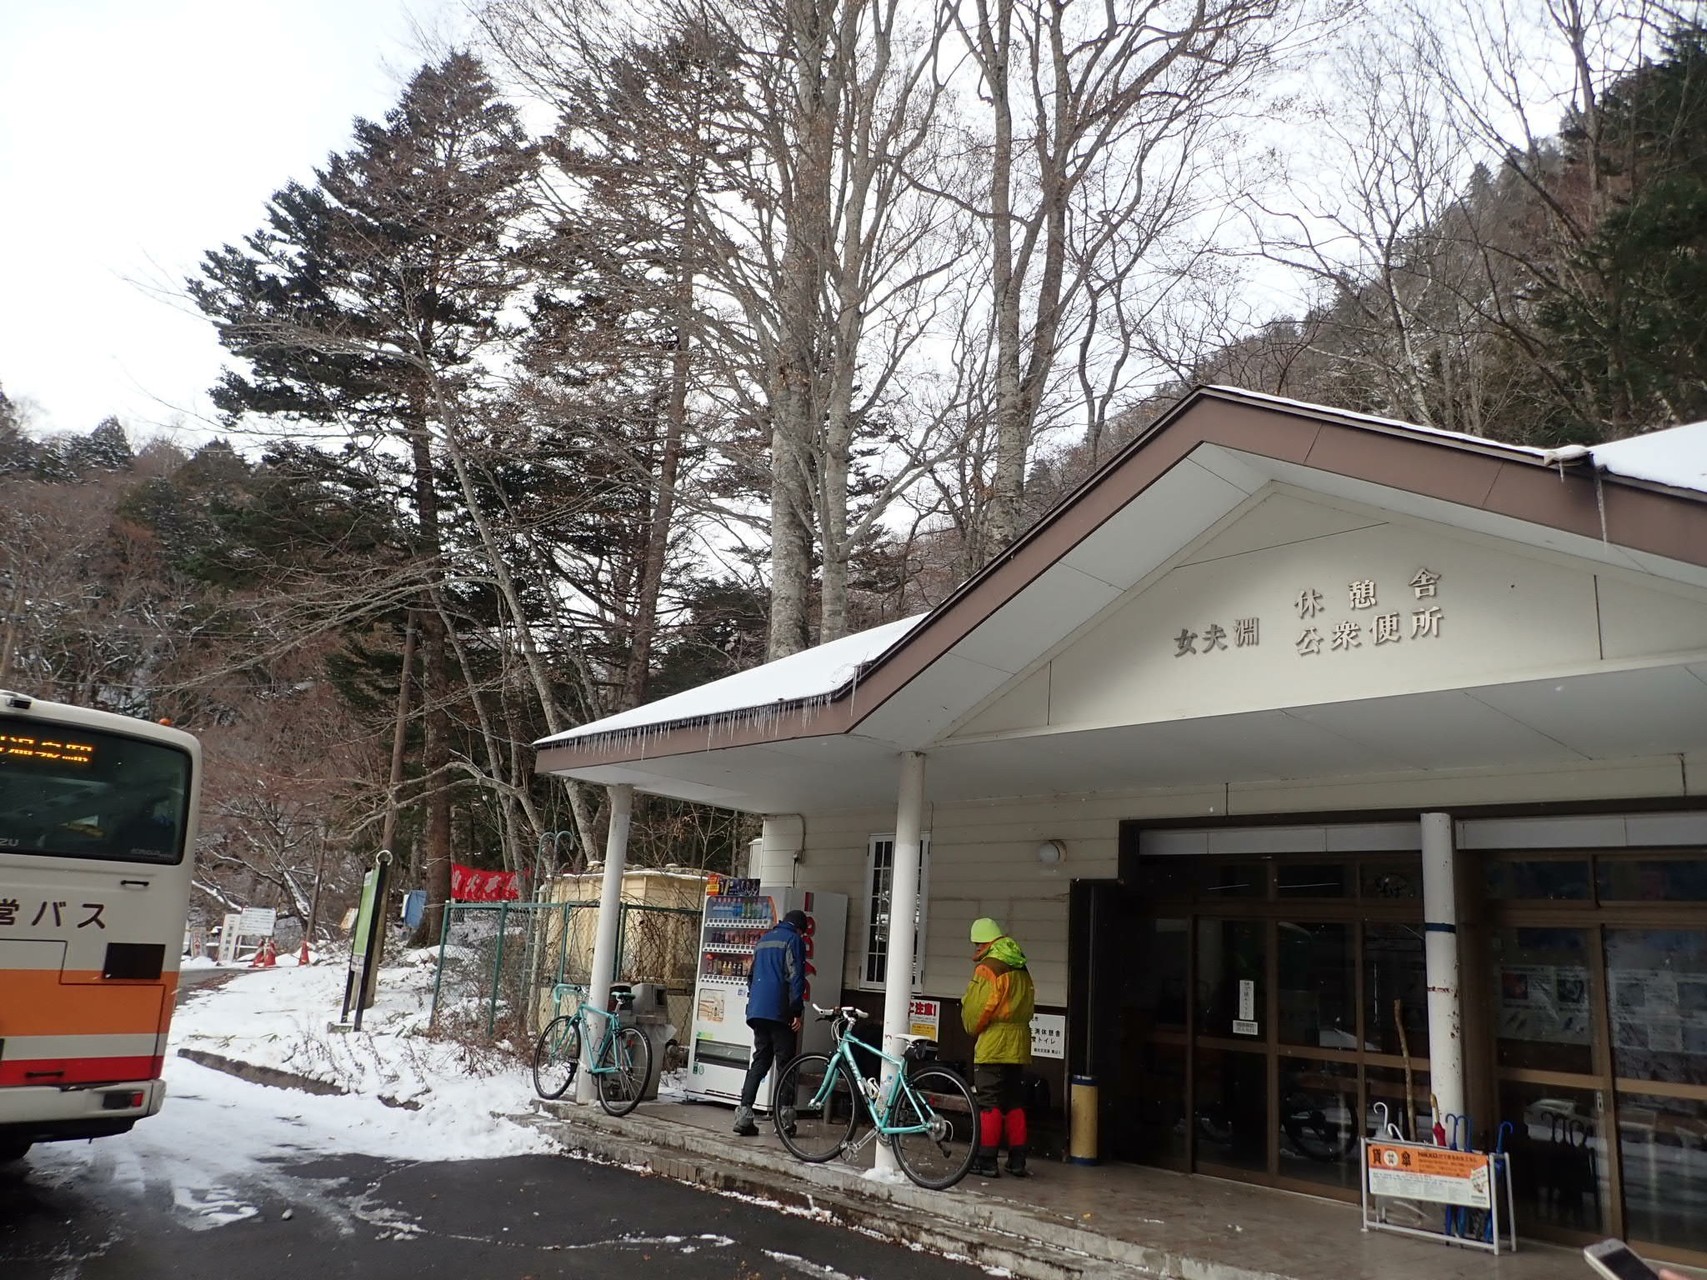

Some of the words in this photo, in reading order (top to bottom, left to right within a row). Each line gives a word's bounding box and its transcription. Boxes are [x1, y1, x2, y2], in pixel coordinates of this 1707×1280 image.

[1295, 567, 1442, 619] 休憩舎
[1174, 617, 1260, 657] 女夫淵
[1296, 606, 1444, 655] 公衆便所
[0, 899, 105, 929] 営バス
